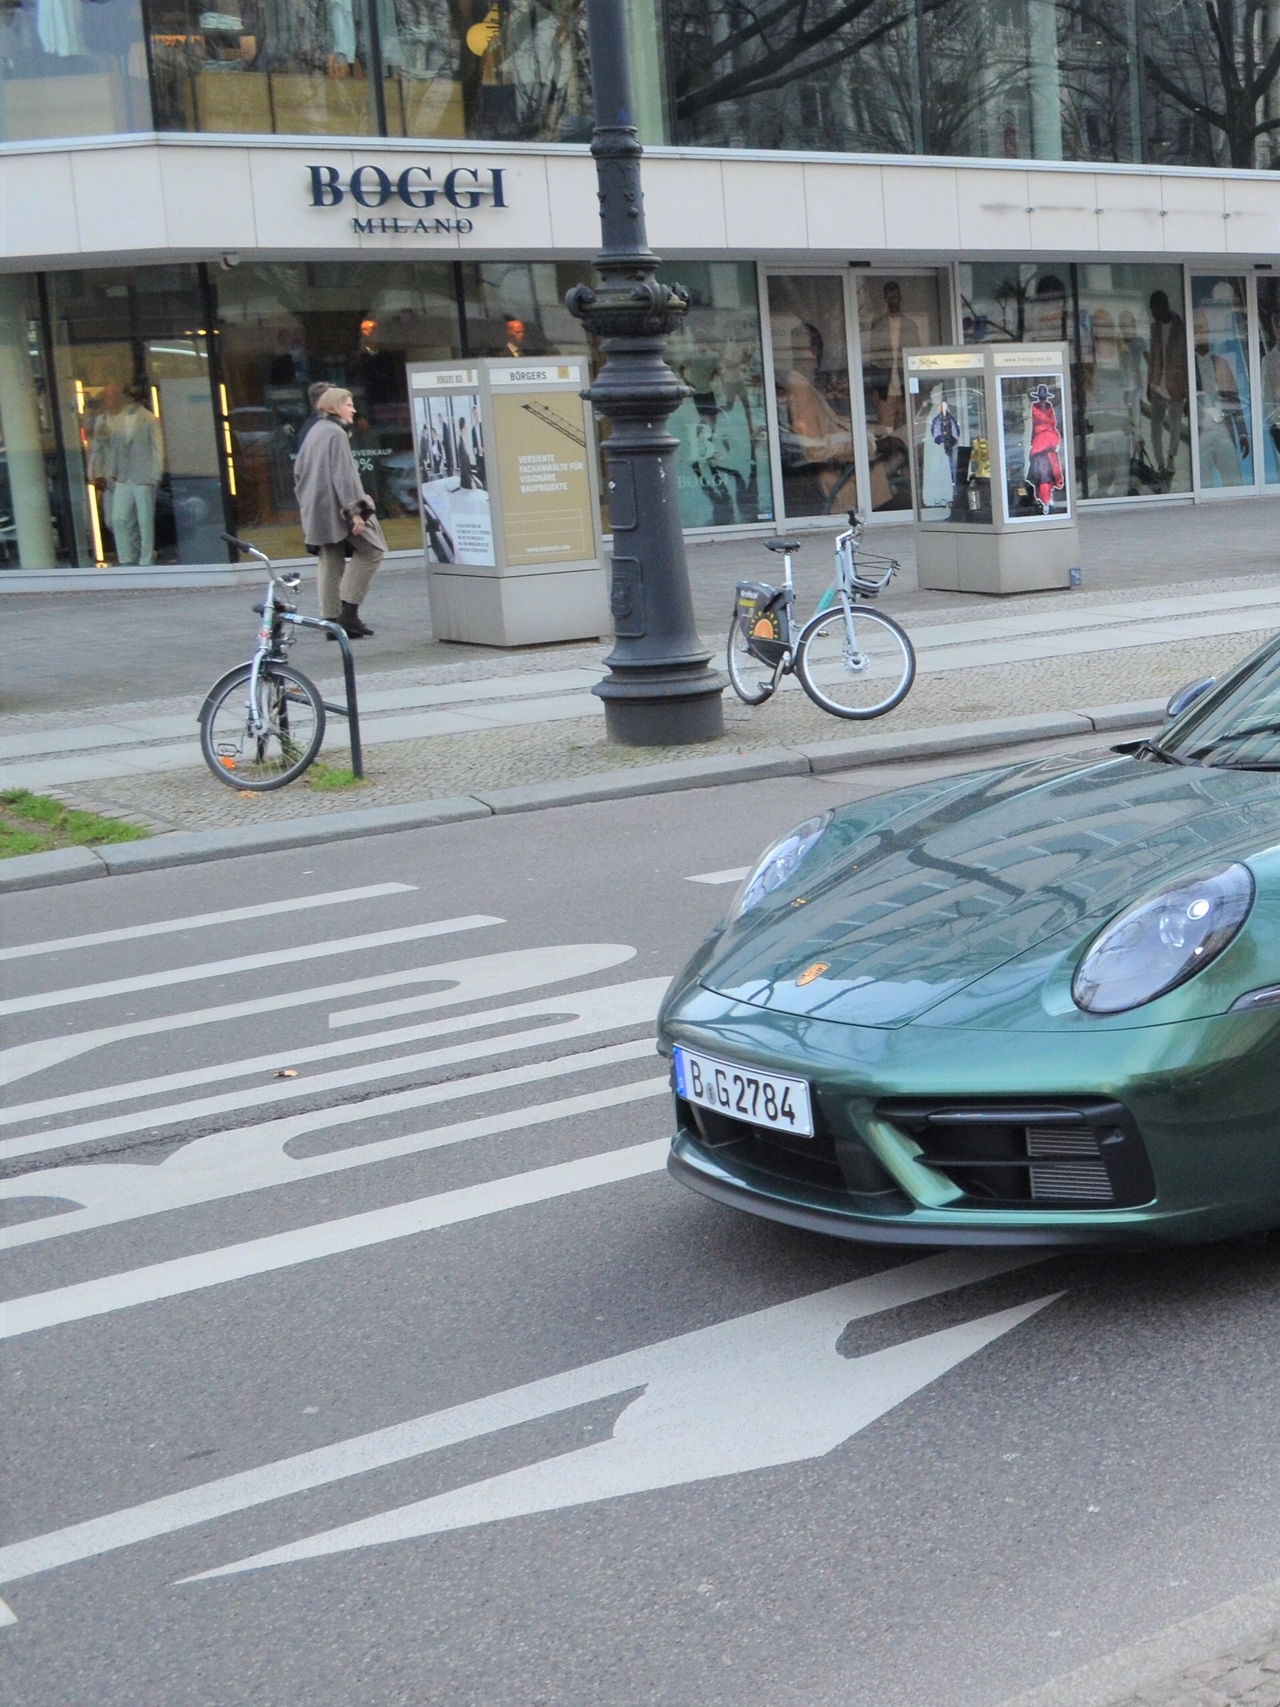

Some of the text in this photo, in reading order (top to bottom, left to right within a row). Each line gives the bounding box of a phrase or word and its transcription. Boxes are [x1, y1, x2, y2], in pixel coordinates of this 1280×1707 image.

[305, 165, 509, 209] BOGGI
[351, 217, 474, 234] MILANO
[510, 371, 547, 381] BÖRGERS
[518, 454, 555, 464] VERSIERTE
[519, 461, 584, 473] FACHANWÄLTE FÜR
[520, 473, 557, 483] VISIONÄRE
[521, 482, 568, 493] BAUPROJEKTE
[690, 1059, 704, 1099] B
